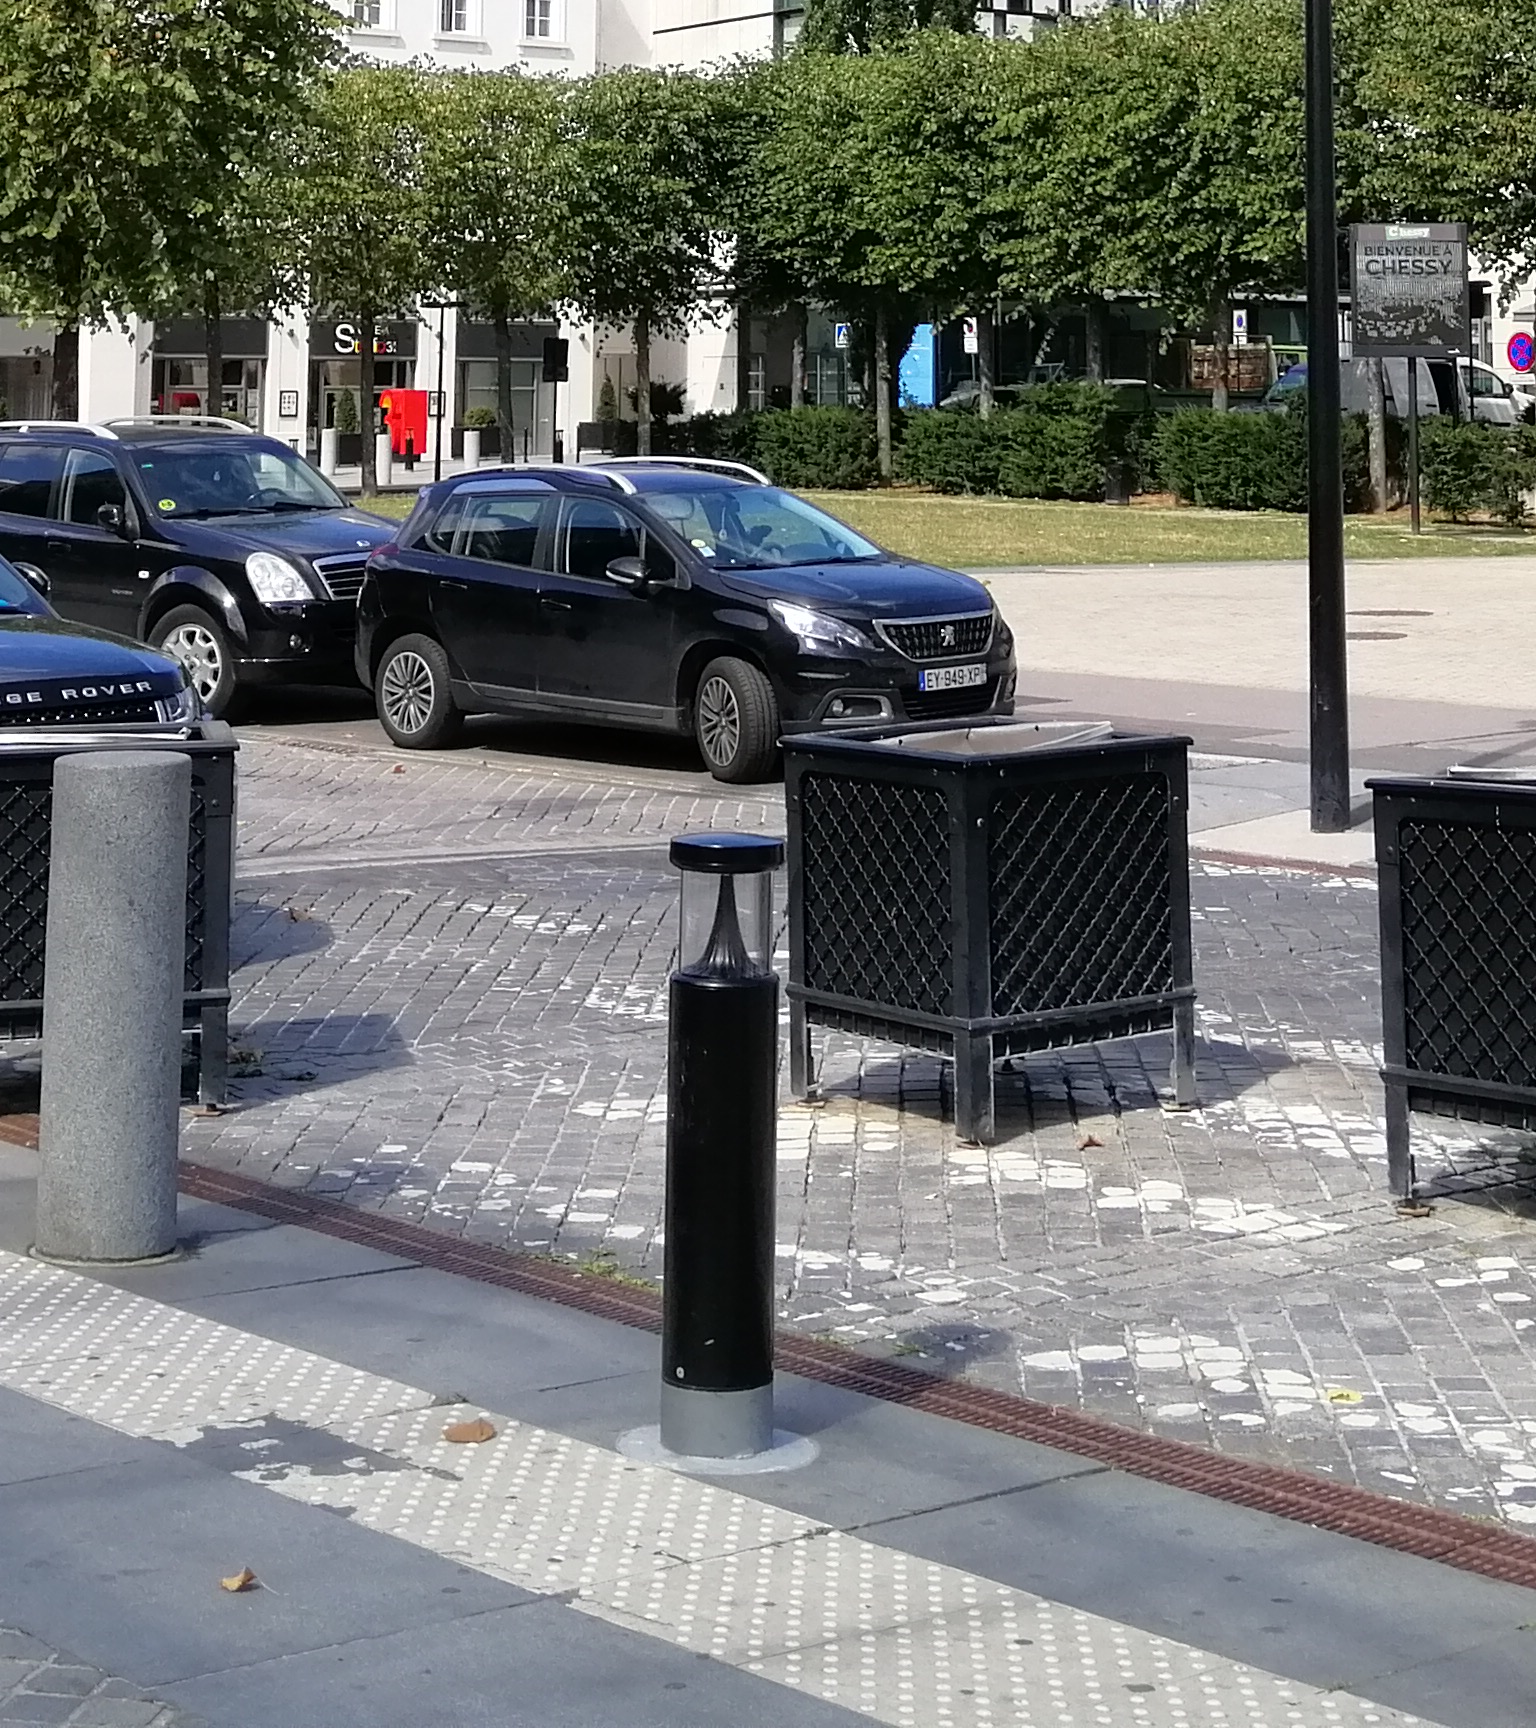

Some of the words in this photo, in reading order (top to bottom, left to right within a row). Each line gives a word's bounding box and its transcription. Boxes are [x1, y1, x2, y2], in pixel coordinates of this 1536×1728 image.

[1364, 245, 1440, 257] BIENVENUE
[1365, 258, 1452, 276] CHESSY
[927, 667, 980, 689] EY-949-XP
[61, 680, 152, 700] ROVER
